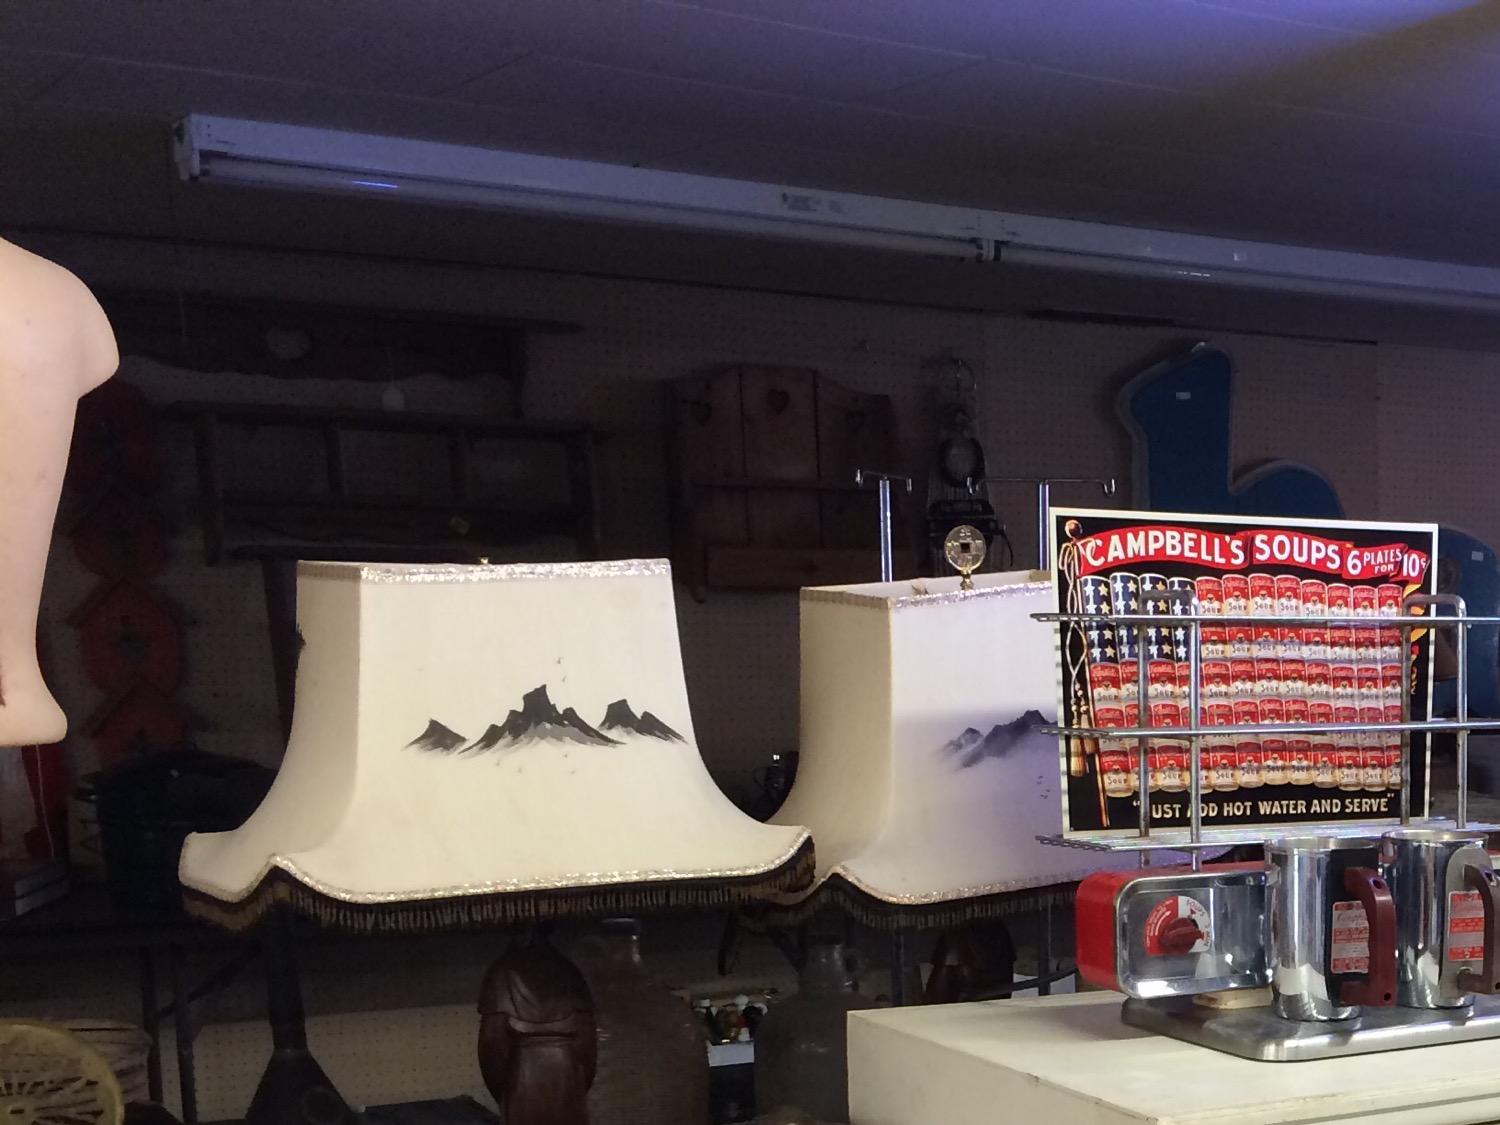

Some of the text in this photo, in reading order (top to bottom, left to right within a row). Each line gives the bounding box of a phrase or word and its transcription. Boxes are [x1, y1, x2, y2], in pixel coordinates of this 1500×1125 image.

[1086, 530, 1245, 566] CAMPBELL'S
[1255, 534, 1341, 569] SOUPS
[1347, 550, 1362, 575] 6
[1364, 548, 1402, 565] PLATES
[1374, 563, 1394, 573] FOR
[1223, 801, 1252, 817] HOT
[1258, 800, 1307, 815] WATER
[1310, 799, 1341, 814] AND
[1345, 793, 1395, 813] SERVE"
[1186, 899, 1205, 917] SOUPS
